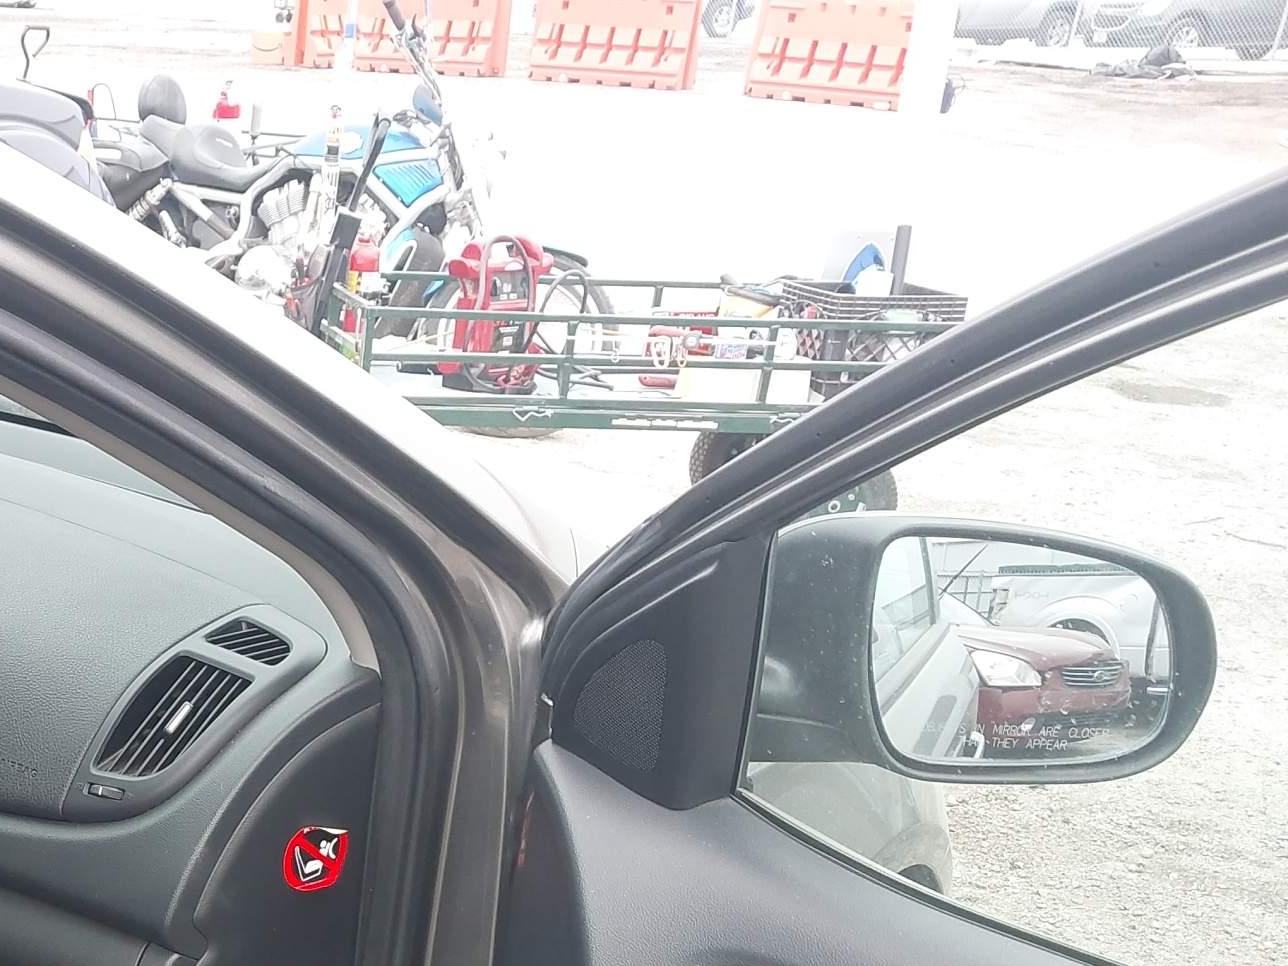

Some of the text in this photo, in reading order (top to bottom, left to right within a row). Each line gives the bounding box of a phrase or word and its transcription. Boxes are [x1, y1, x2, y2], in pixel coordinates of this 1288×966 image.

[1039, 726, 1062, 737] ARE
[1068, 727, 1110, 739] CLOSER
[992, 737, 1019, 749] THEY
[1026, 738, 1068, 751] APPEAR
